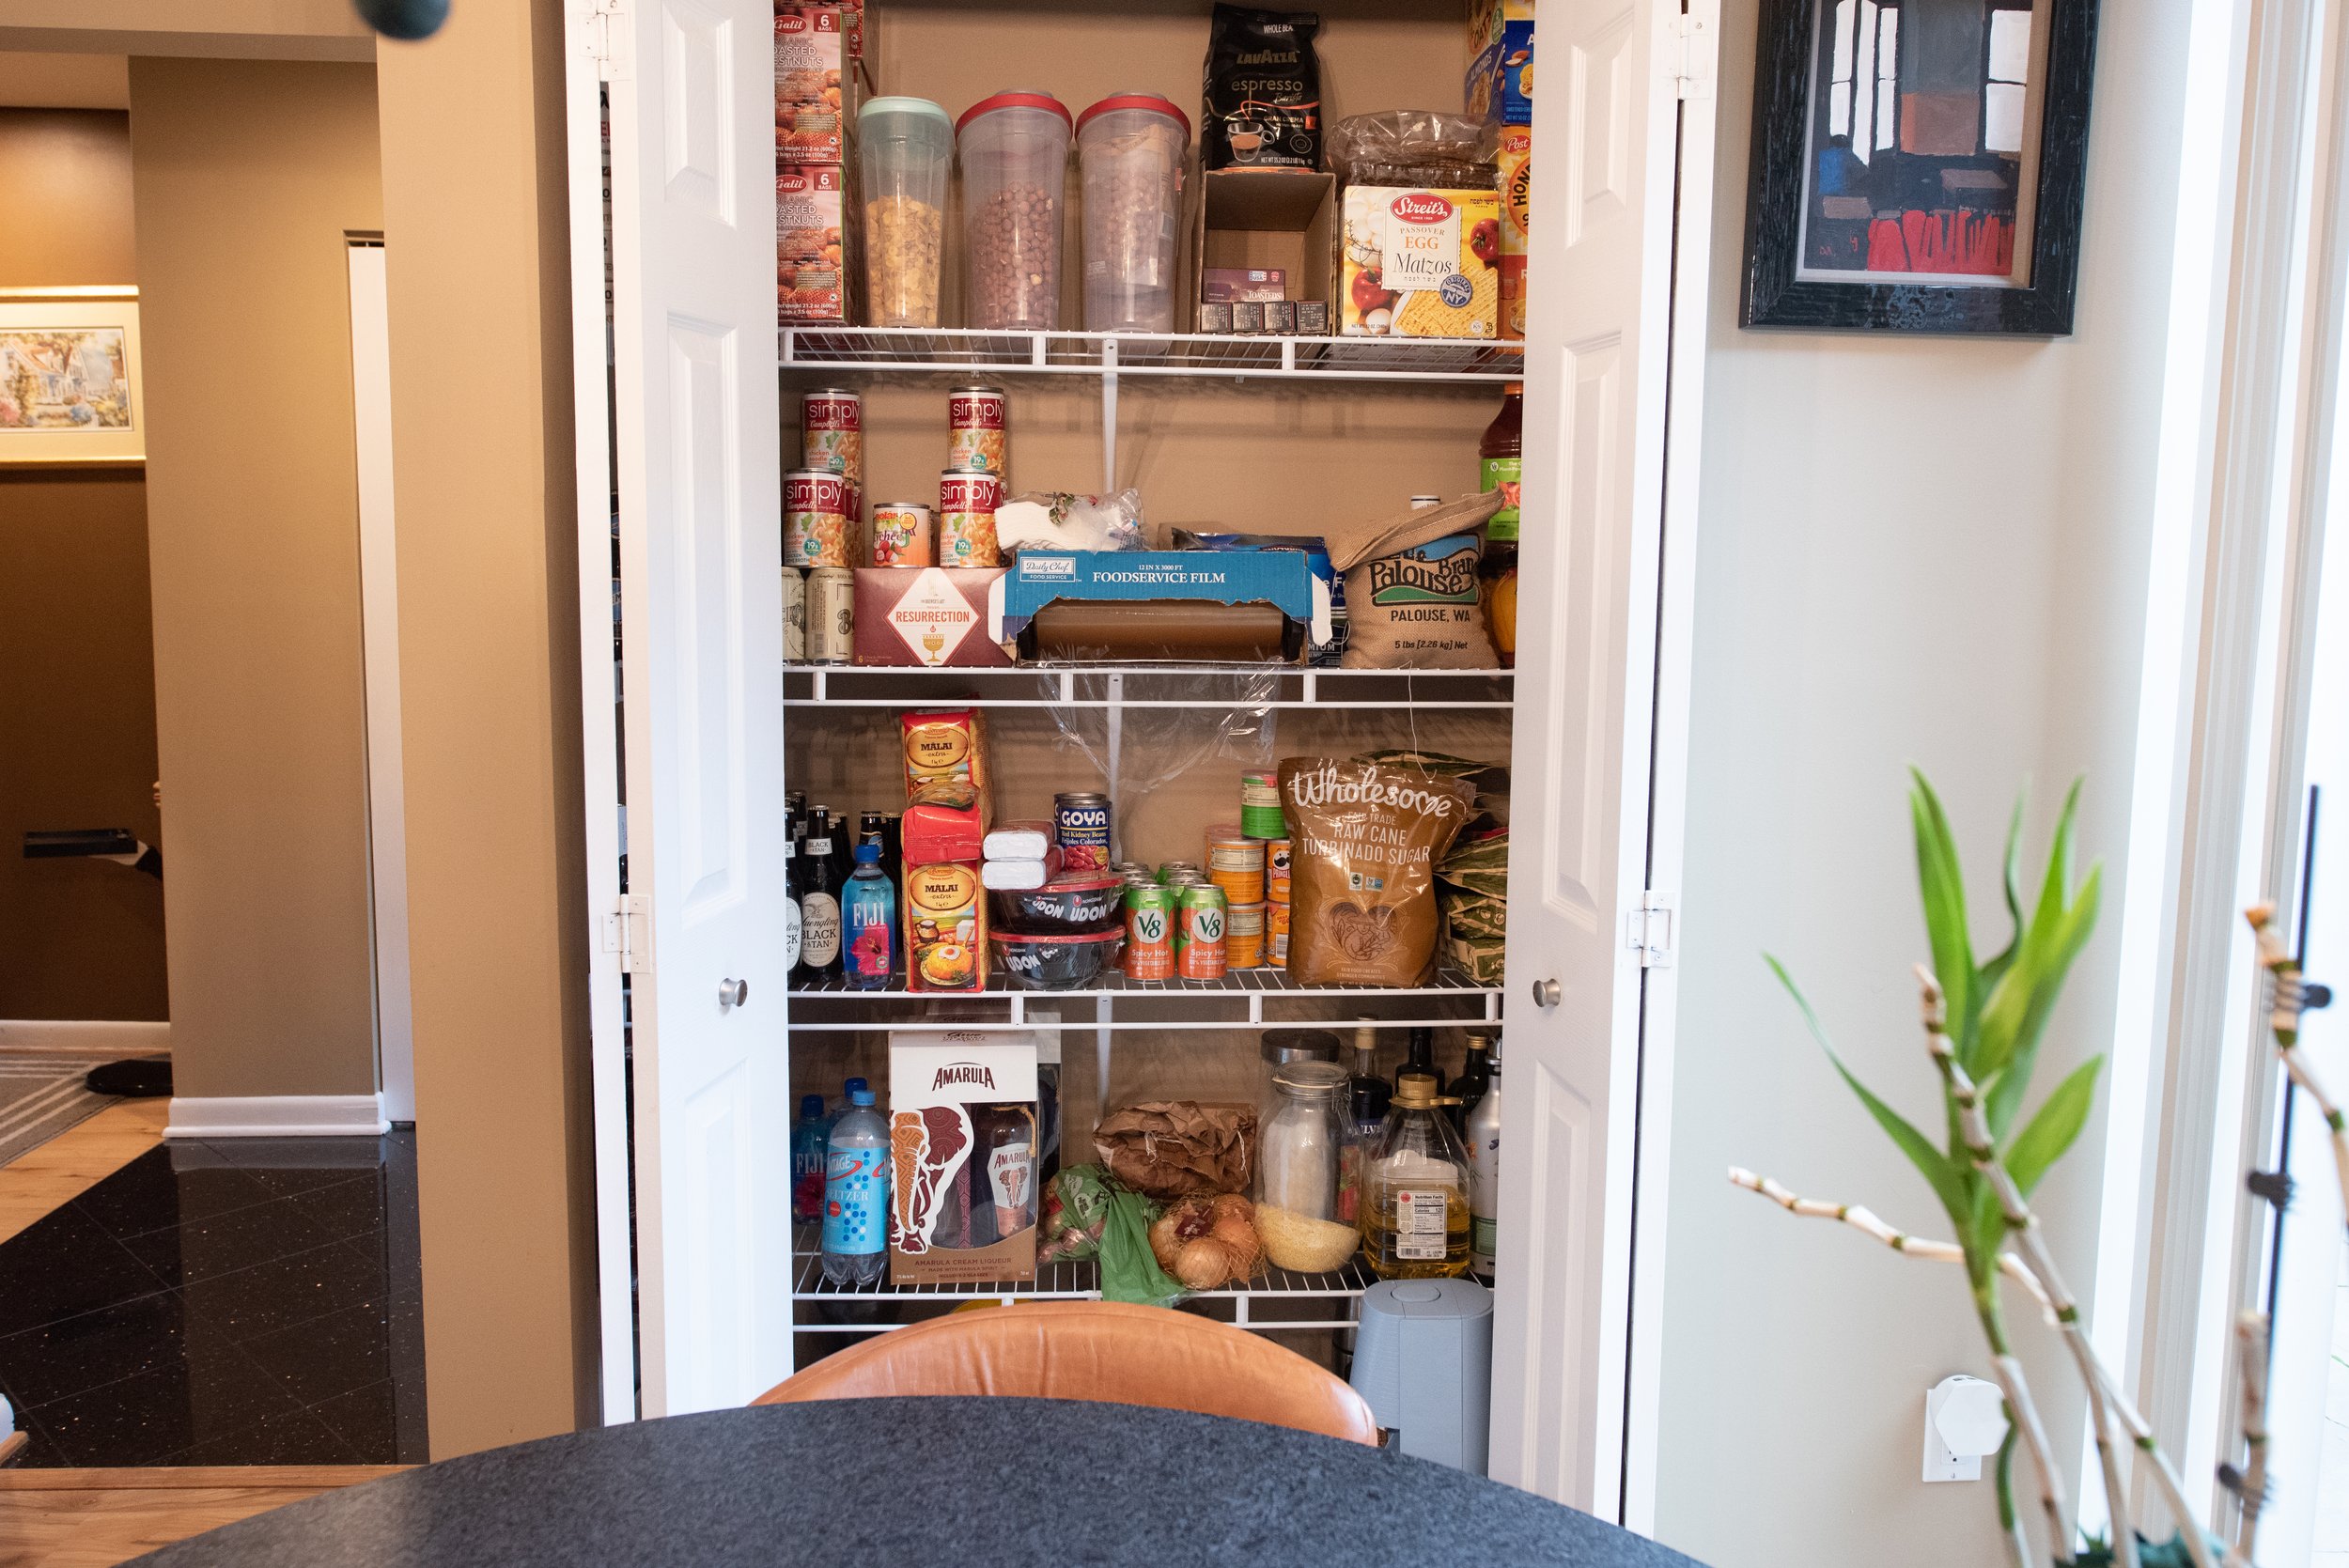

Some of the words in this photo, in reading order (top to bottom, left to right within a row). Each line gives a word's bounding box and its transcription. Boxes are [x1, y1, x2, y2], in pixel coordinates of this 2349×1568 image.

[774, 19, 803, 29] Galil
[820, 15, 830, 26] 6
[1263, 24, 1282, 34] WHOLE
[1283, 23, 1294, 33] BEA
[774, 37, 814, 46] RGANIC
[774, 46, 817, 55] OASTED
[1237, 49, 1299, 65] LAVAZZA
[774, 57, 824, 67] ESTNUTS
[1470, 51, 1492, 82] ALMONDS
[1231, 79, 1304, 92] espresso
[1507, 137, 1530, 151] Post
[776, 179, 804, 189] Galil
[820, 173, 830, 185] 6
[777, 195, 814, 205] RGANIC
[1394, 196, 1449, 218] Streit's
[776, 205, 817, 215] ASTED
[776, 215, 824, 225] STNUTS
[1400, 226, 1446, 236] PASSOVER
[1404, 236, 1439, 250] EGG
[1392, 253, 1453, 275] Matzos
[1445, 290, 1466, 304] NY
[809, 401, 860, 424] simply
[953, 400, 1003, 423] simply
[786, 481, 843, 506] simply
[941, 482, 995, 506] simply
[875, 530, 903, 545] ychee
[1025, 562, 1049, 572] Daily
[1439, 557, 1478, 579] Bran
[1093, 571, 1188, 583] FOODSERVICE
[1189, 572, 1226, 584] FILM
[1368, 560, 1475, 596] Palouse
[895, 611, 971, 623] RESURRECTION
[1391, 609, 1450, 623] PALOUSE,
[1454, 609, 1470, 622] WA
[1308, 644, 1335, 652] MIUM
[1394, 640, 1401, 649] 5
[1402, 639, 1415, 649] lbs
[1454, 641, 1469, 649] Net
[858, 655, 863, 663] 6
[1293, 766, 1453, 818] Wholesome
[1061, 810, 1106, 827] GOYA
[1369, 813, 1397, 826] TRADE
[1071, 831, 1090, 840] Kidney
[1333, 825, 1365, 839] RAW
[1369, 825, 1408, 846] CANE
[1301, 837, 1384, 862] TURBINADO
[1388, 846, 1431, 866] SUGAR
[1273, 869, 1291, 879] PRINGL
[853, 902, 885, 927] FIJI
[1033, 900, 1066, 919] UDON
[1070, 904, 1107, 922] UDON
[1137, 912, 1161, 939] V8
[1198, 912, 1221, 938] V8
[801, 929, 836, 939] BLACK
[1131, 949, 1153, 959] Spicy
[1190, 948, 1212, 957] Spicy
[1005, 955, 1041, 971] UDON
[931, 1066, 996, 1092] AMARULA
[796, 1154, 825, 1174] FIJI
[827, 1155, 851, 1174] NTAGE
[994, 1149, 1031, 1170] AMARULA
